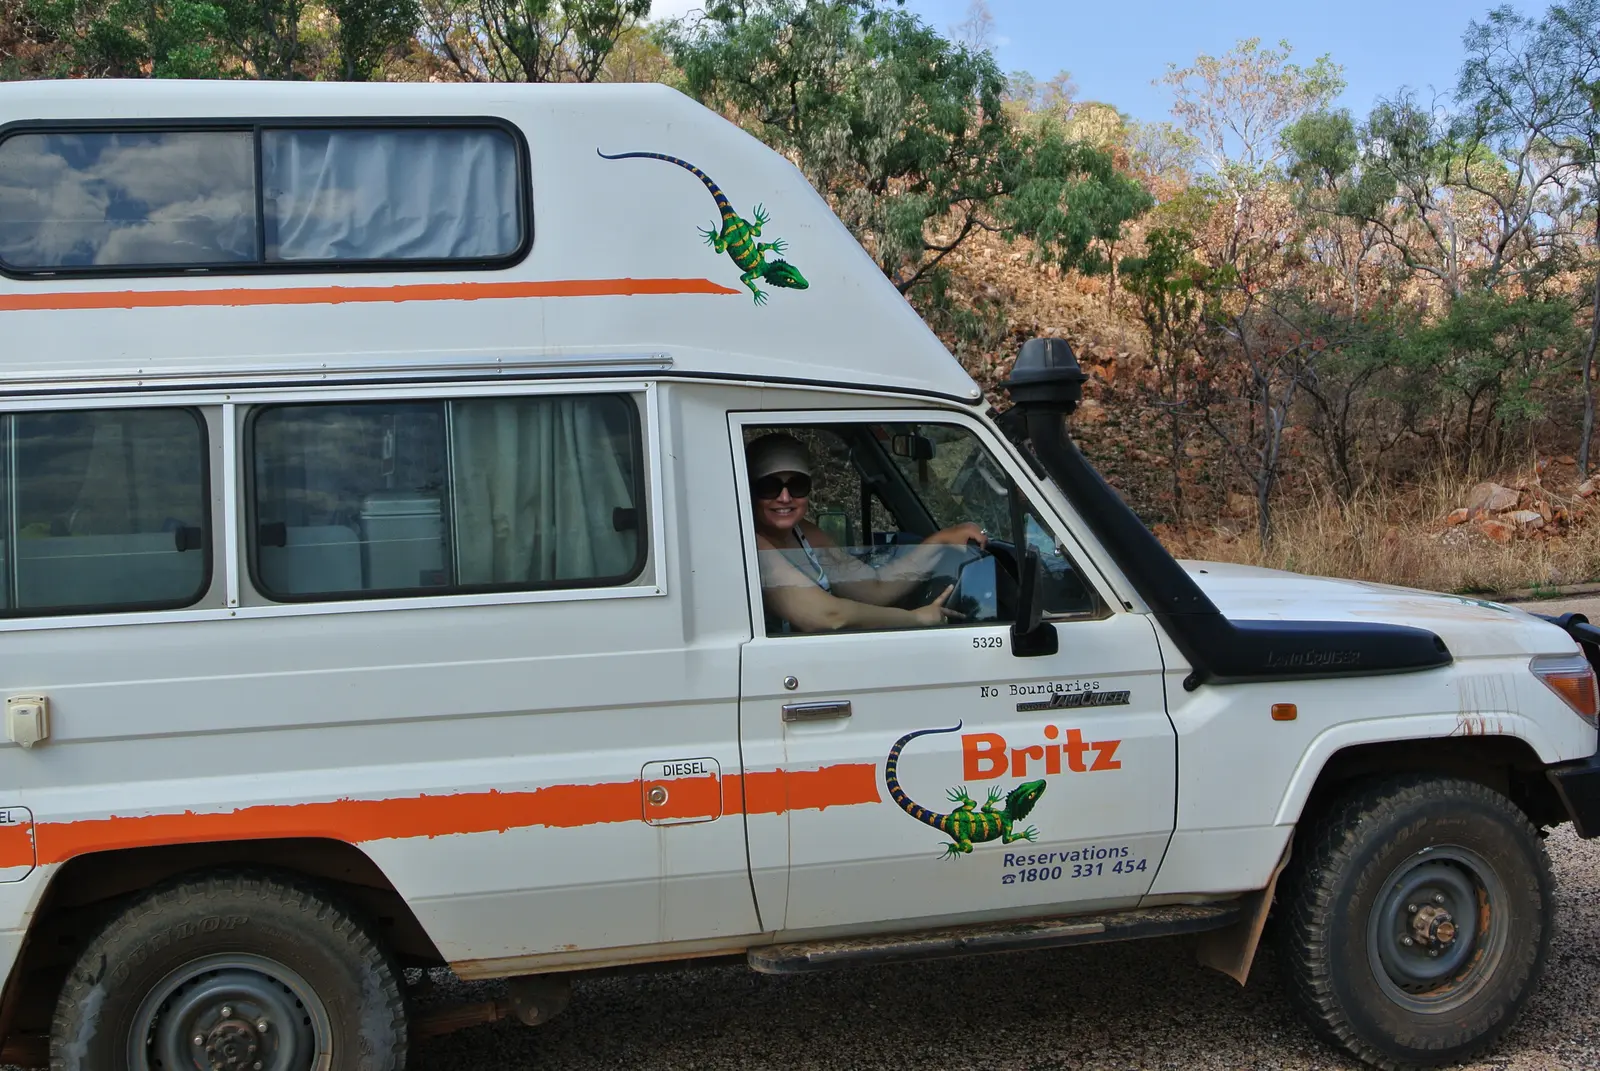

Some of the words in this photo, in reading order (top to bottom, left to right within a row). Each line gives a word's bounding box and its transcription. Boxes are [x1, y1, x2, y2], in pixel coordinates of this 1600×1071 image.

[972, 637, 1003, 649] 5329
[980, 686, 999, 698] No
[1009, 680, 1100, 696] Boundaries
[961, 724, 1122, 781] Britz
[663, 762, 708, 777] DIESEL
[1003, 846, 1129, 867] Reservations
[1018, 866, 1062, 883] 1800
[1071, 863, 1104, 878] 331
[1112, 859, 1147, 874] 454
